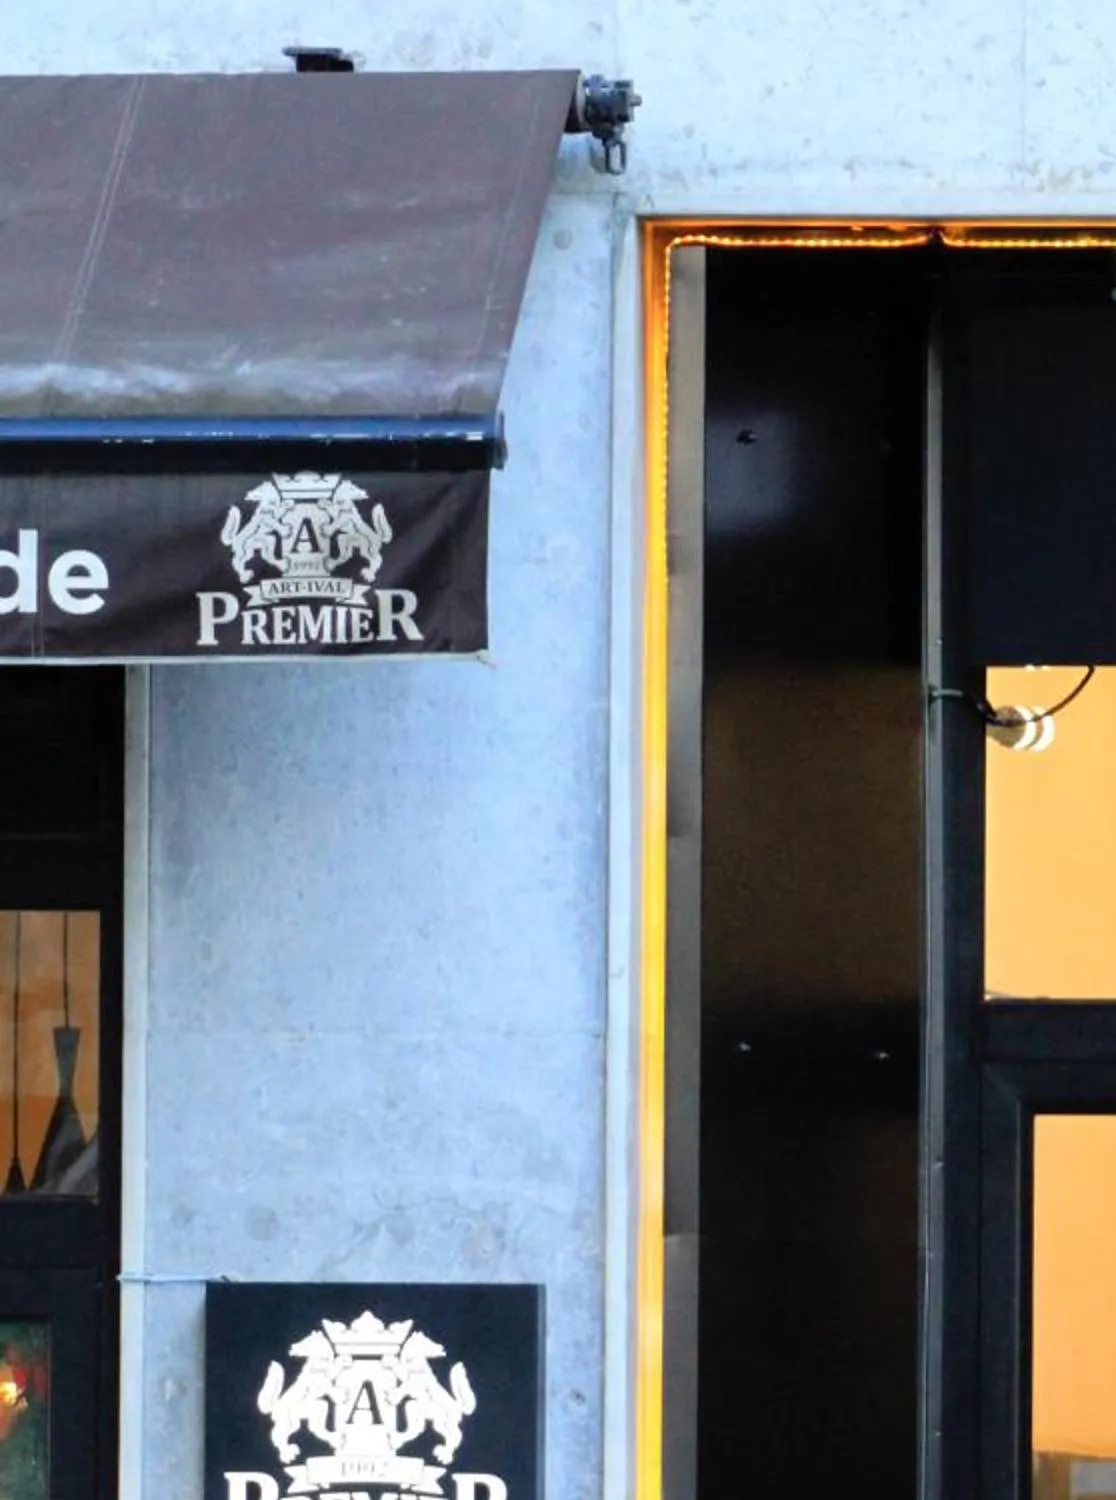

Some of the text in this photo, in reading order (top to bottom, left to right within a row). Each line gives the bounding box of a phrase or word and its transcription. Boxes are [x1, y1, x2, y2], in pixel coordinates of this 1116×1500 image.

[289, 516, 323, 554] A
[196, 588, 425, 646] PREMIER
[345, 1379, 384, 1425] A
